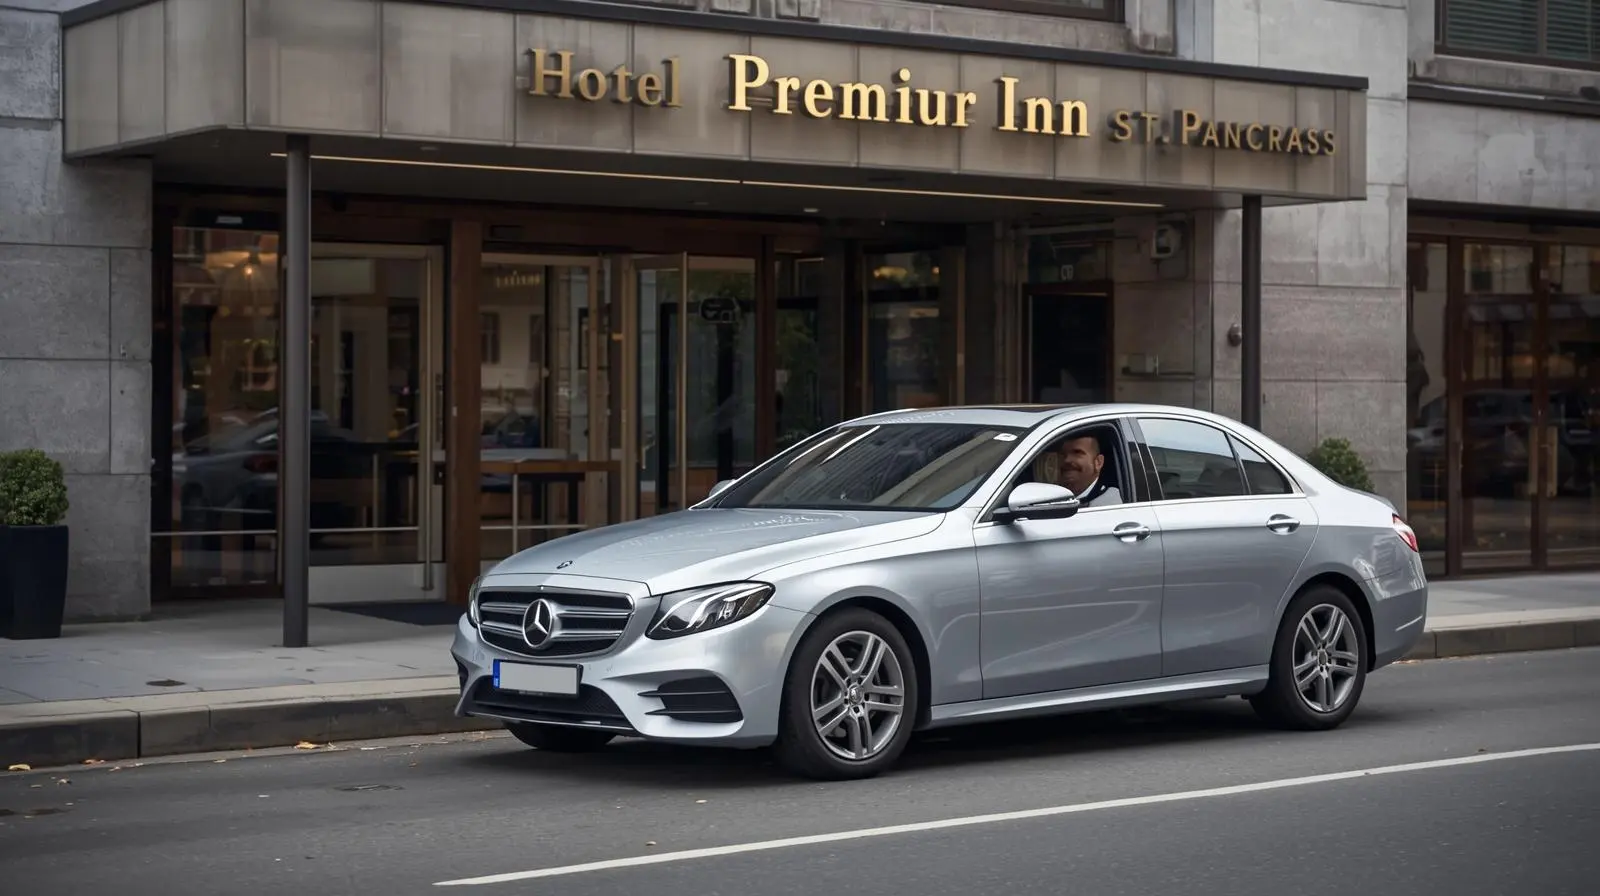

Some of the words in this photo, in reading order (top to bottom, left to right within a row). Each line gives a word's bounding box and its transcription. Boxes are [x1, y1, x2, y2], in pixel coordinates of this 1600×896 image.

[527, 47, 683, 108] Hotel
[727, 53, 977, 127] Premiur
[997, 75, 1091, 137] Inn
